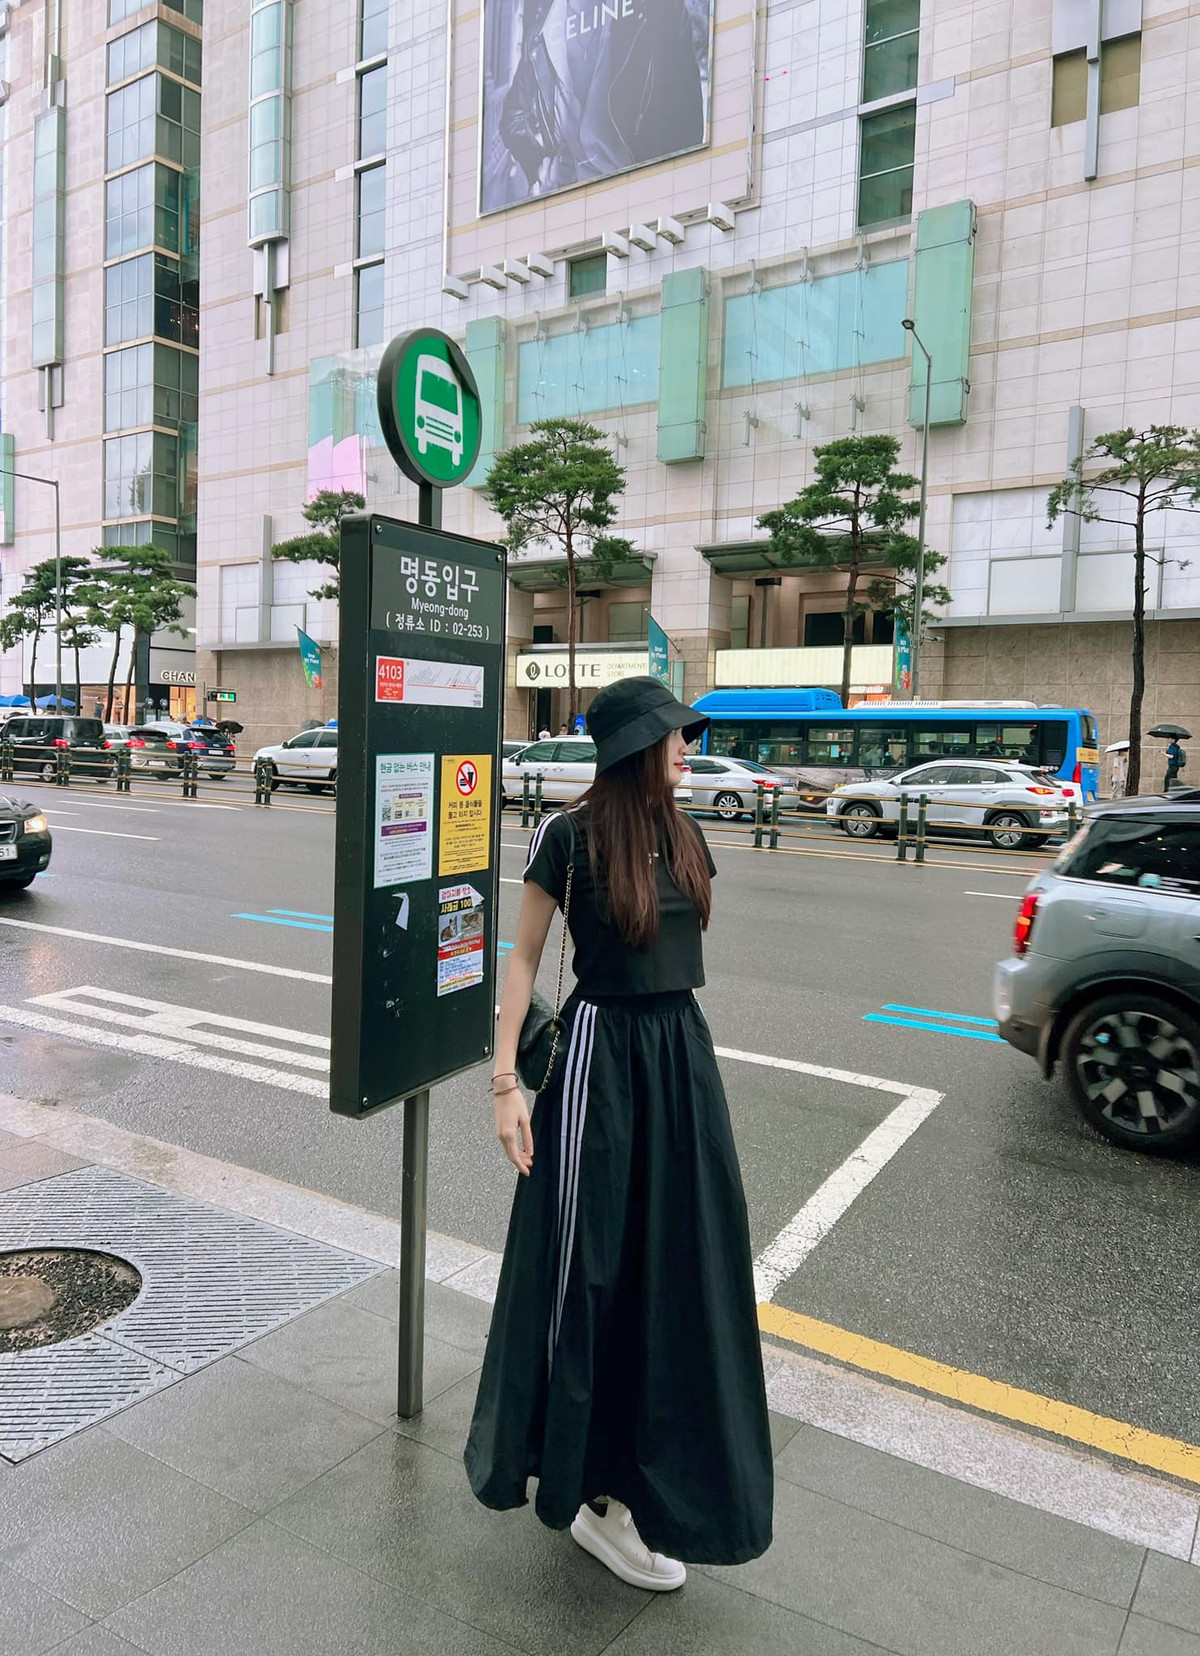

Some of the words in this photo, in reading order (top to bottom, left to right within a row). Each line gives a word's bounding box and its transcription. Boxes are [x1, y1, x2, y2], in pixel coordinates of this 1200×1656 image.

[400, 556, 480, 603] 명동입구
[411, 597, 469, 620] Myeong-dong
[395, 613, 426, 632] 정류소
[430, 618, 441, 633] ID
[452, 623, 483, 639] 02-253
[378, 664, 402, 680] 4103
[607, 662, 646, 670] DEPARTMENT
[607, 670, 625, 678] STORE
[407, 761, 419, 773] 버스
